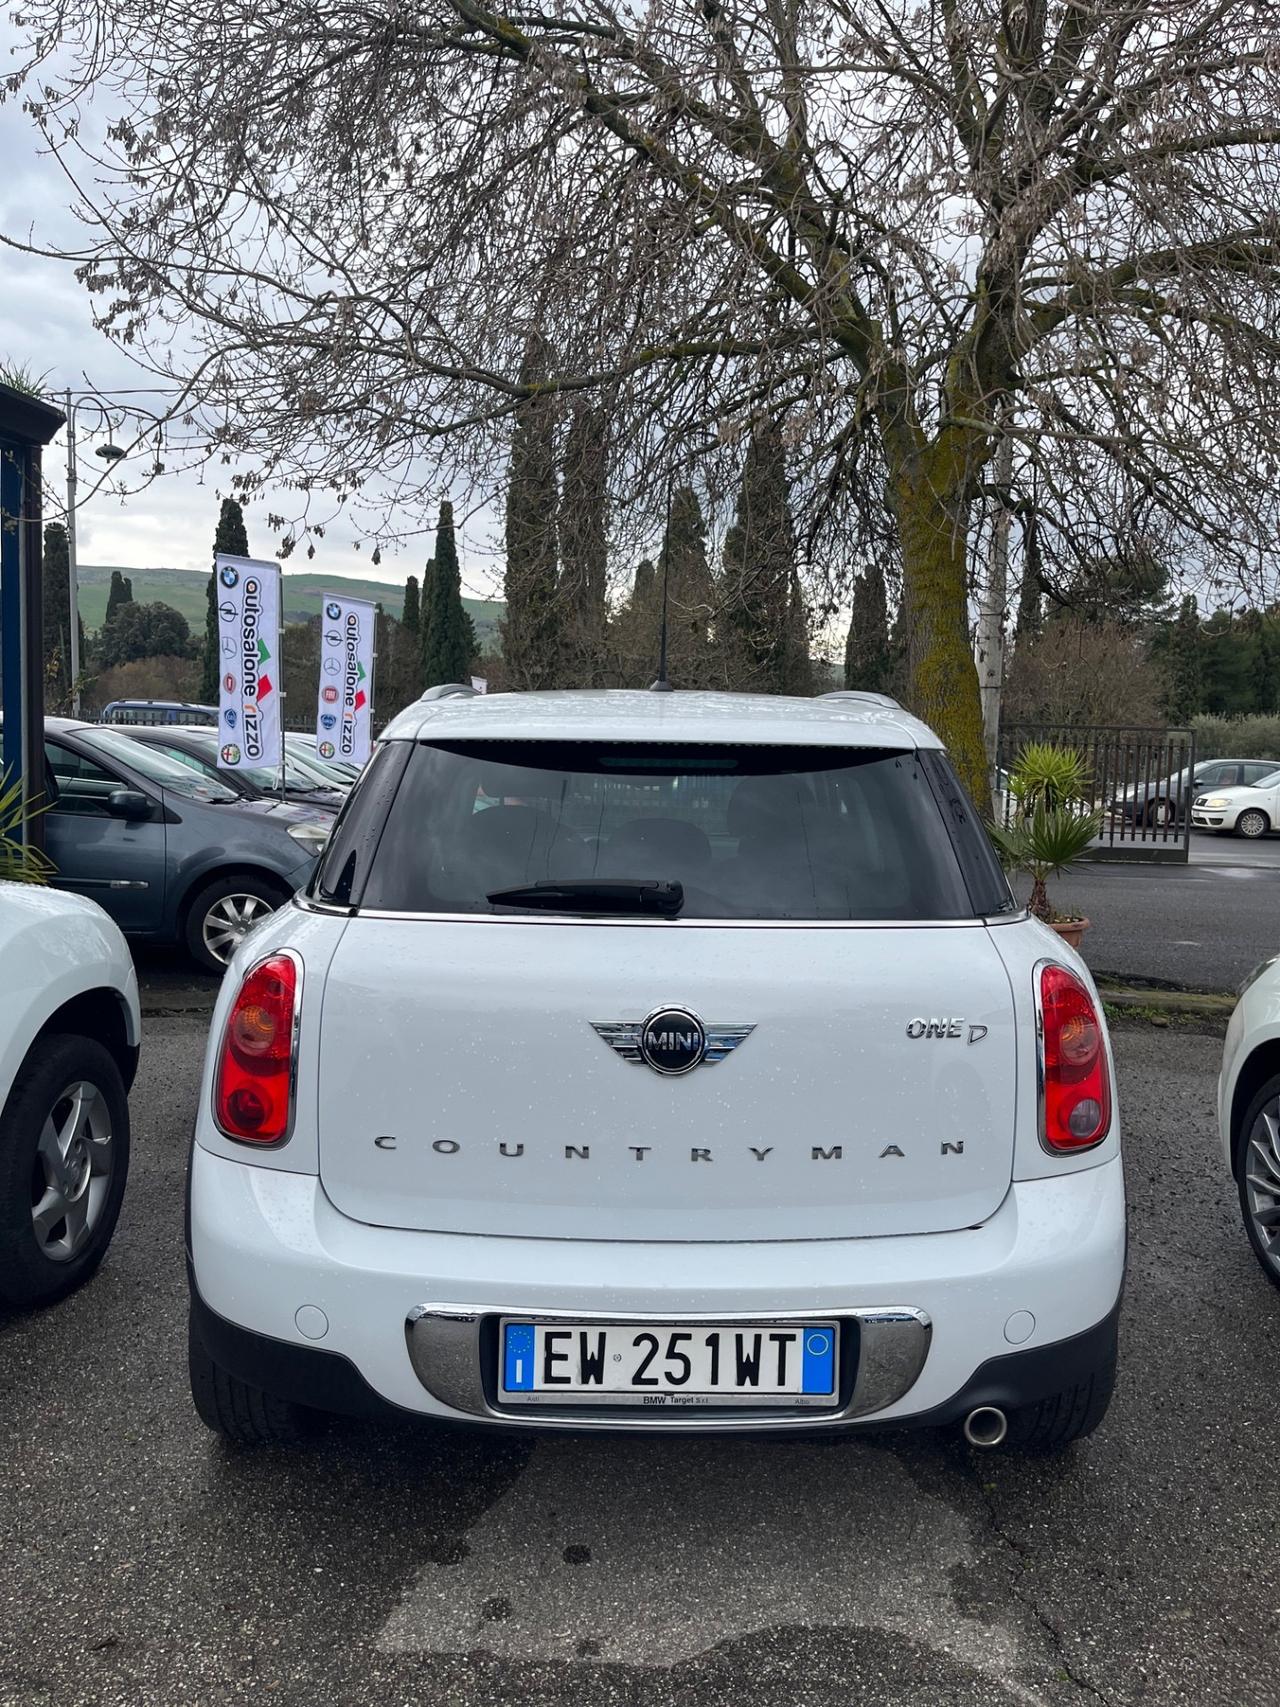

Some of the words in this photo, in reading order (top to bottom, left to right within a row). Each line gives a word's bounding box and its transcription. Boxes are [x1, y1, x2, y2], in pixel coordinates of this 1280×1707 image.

[243, 580, 259, 697] autosalone
[344, 614, 358, 706] autosalone
[244, 704, 260, 756] rizzo
[342, 712, 354, 754] rizzo
[647, 1031, 699, 1051] MINI
[906, 1018, 965, 1039] ONE
[967, 1025, 988, 1046] D
[374, 1135, 965, 1162] COUNTRYMAN
[643, 1396, 667, 1404] BMW
[671, 1396, 694, 1405] Target
